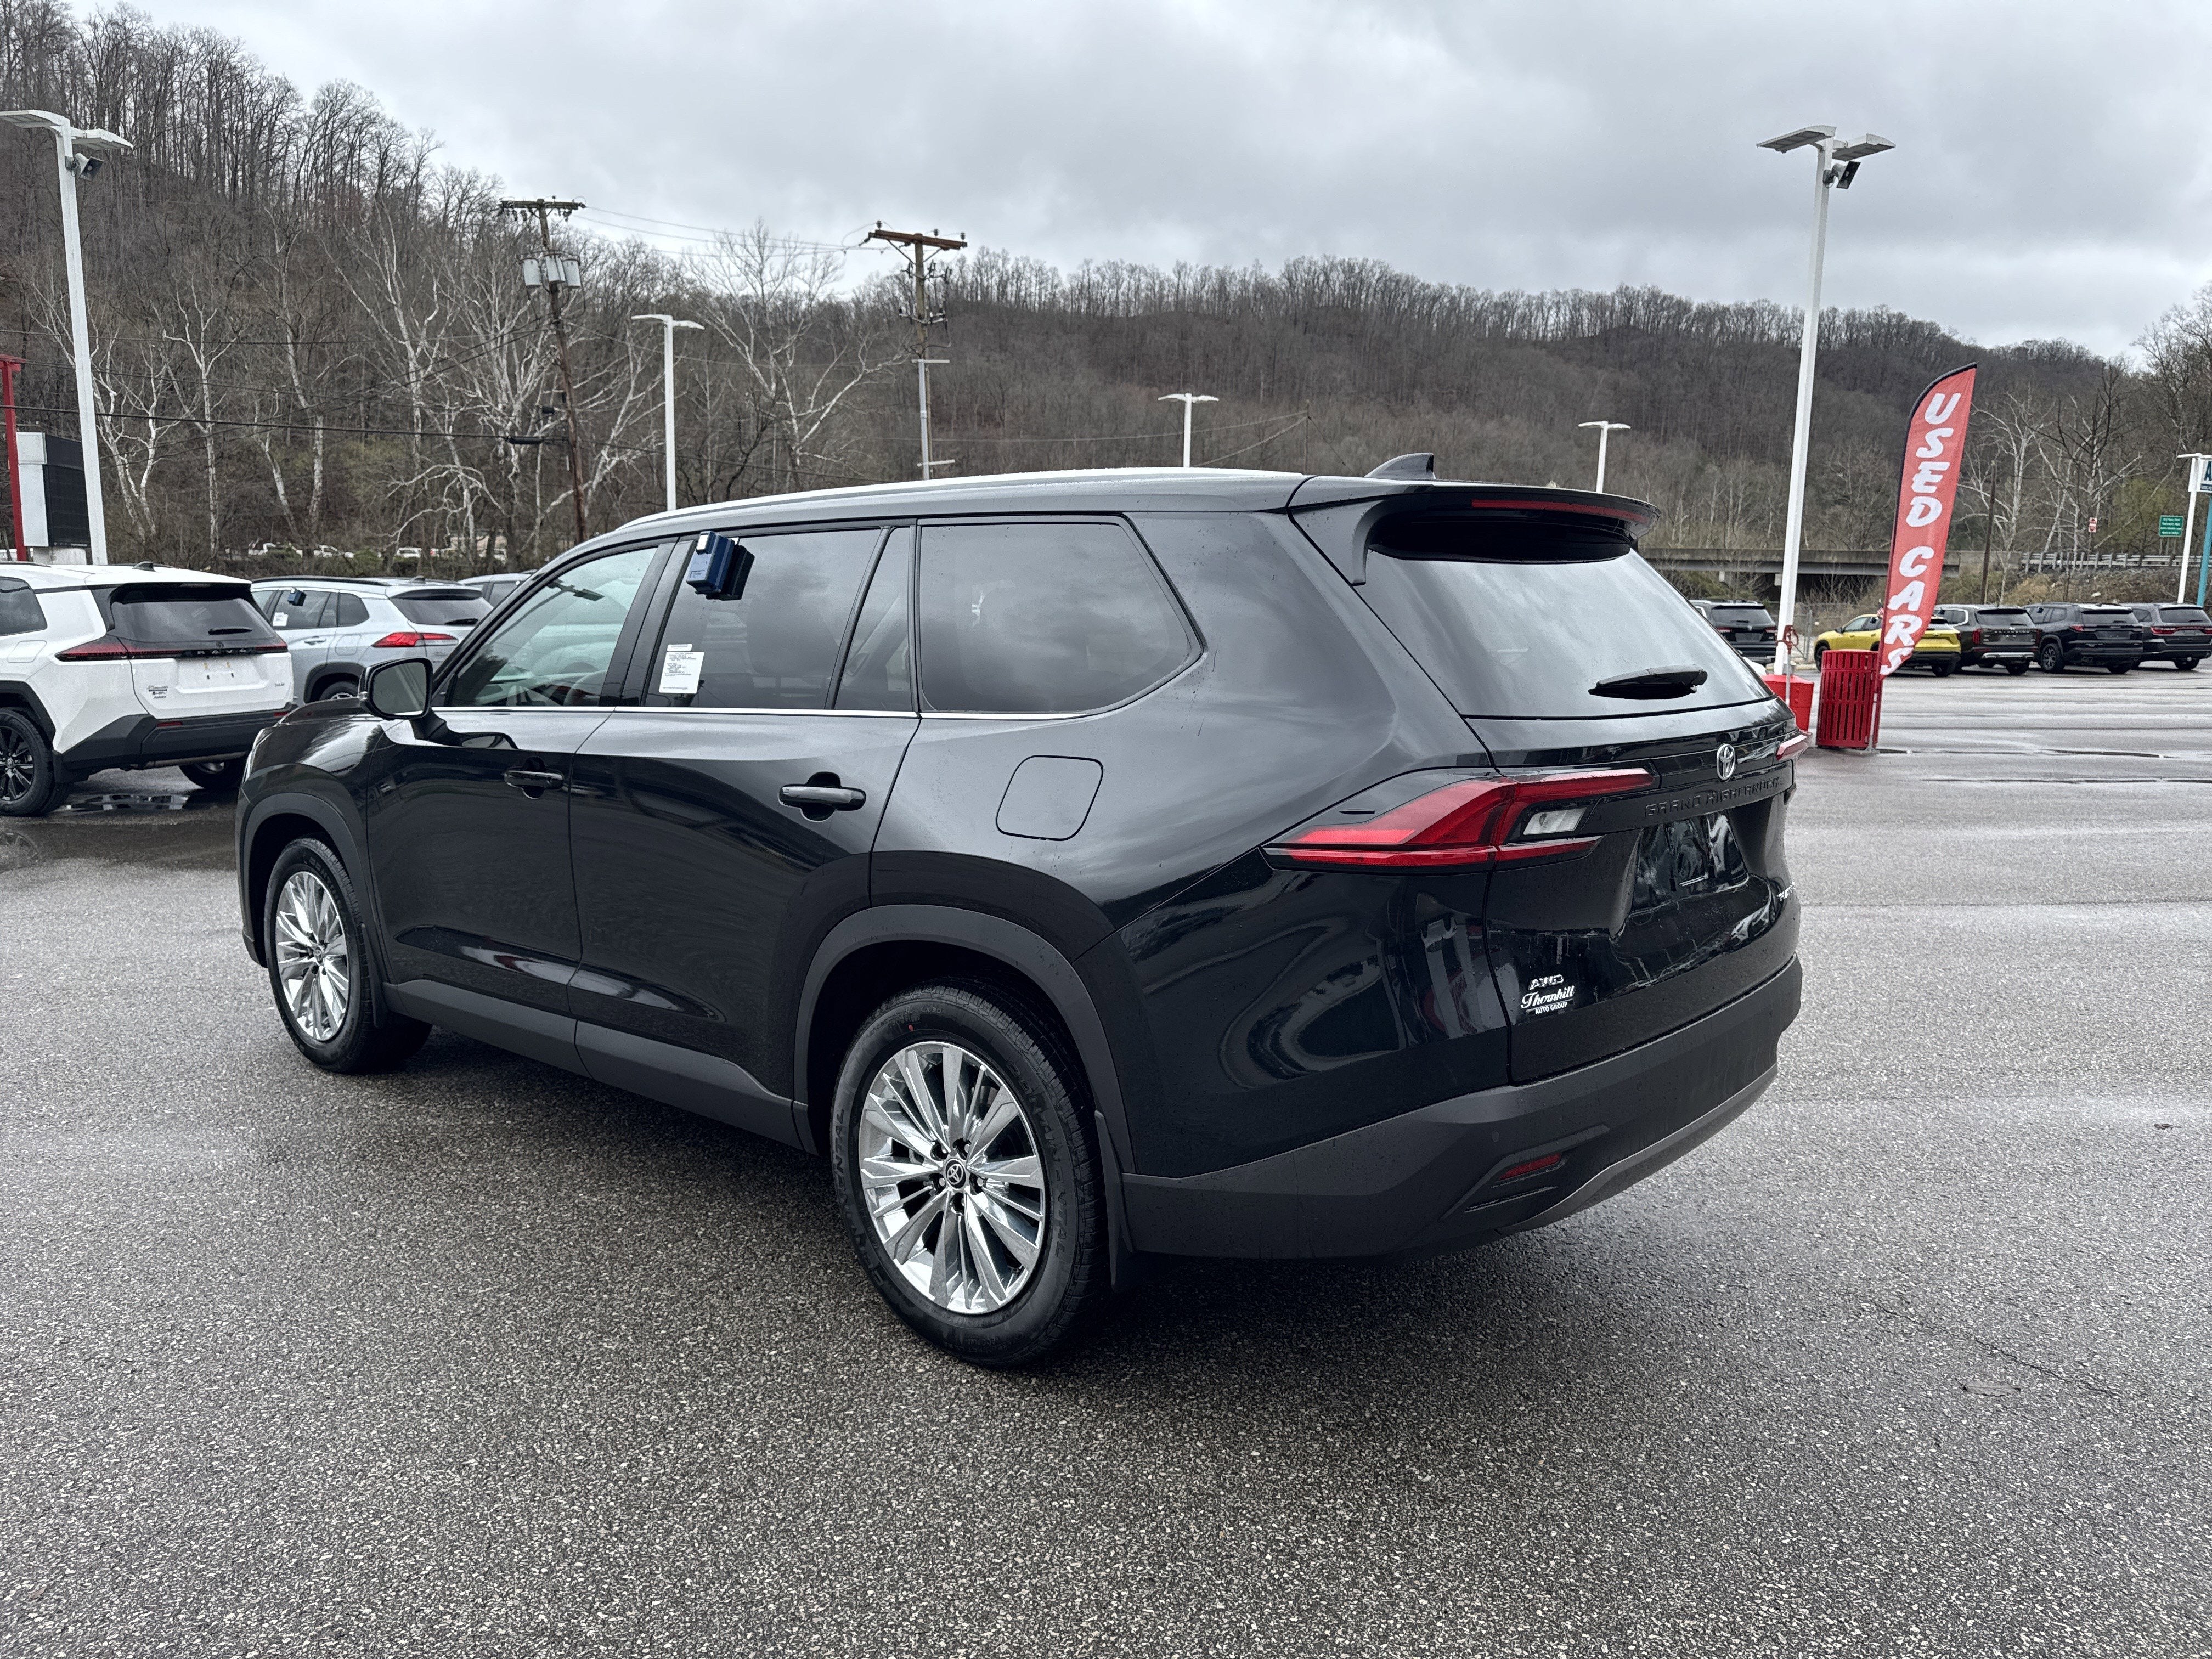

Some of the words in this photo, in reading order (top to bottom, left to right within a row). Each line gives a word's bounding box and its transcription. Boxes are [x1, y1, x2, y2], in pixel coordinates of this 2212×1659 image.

[1906, 393, 1961, 528] USED
[1880, 545, 1935, 675] CARS
[1645, 795, 1701, 816] GRAND
[1520, 985, 1575, 1008] Thornhill
[1535, 1006, 1550, 1015] AUTO
[1550, 1001, 1568, 1011] GROUP
